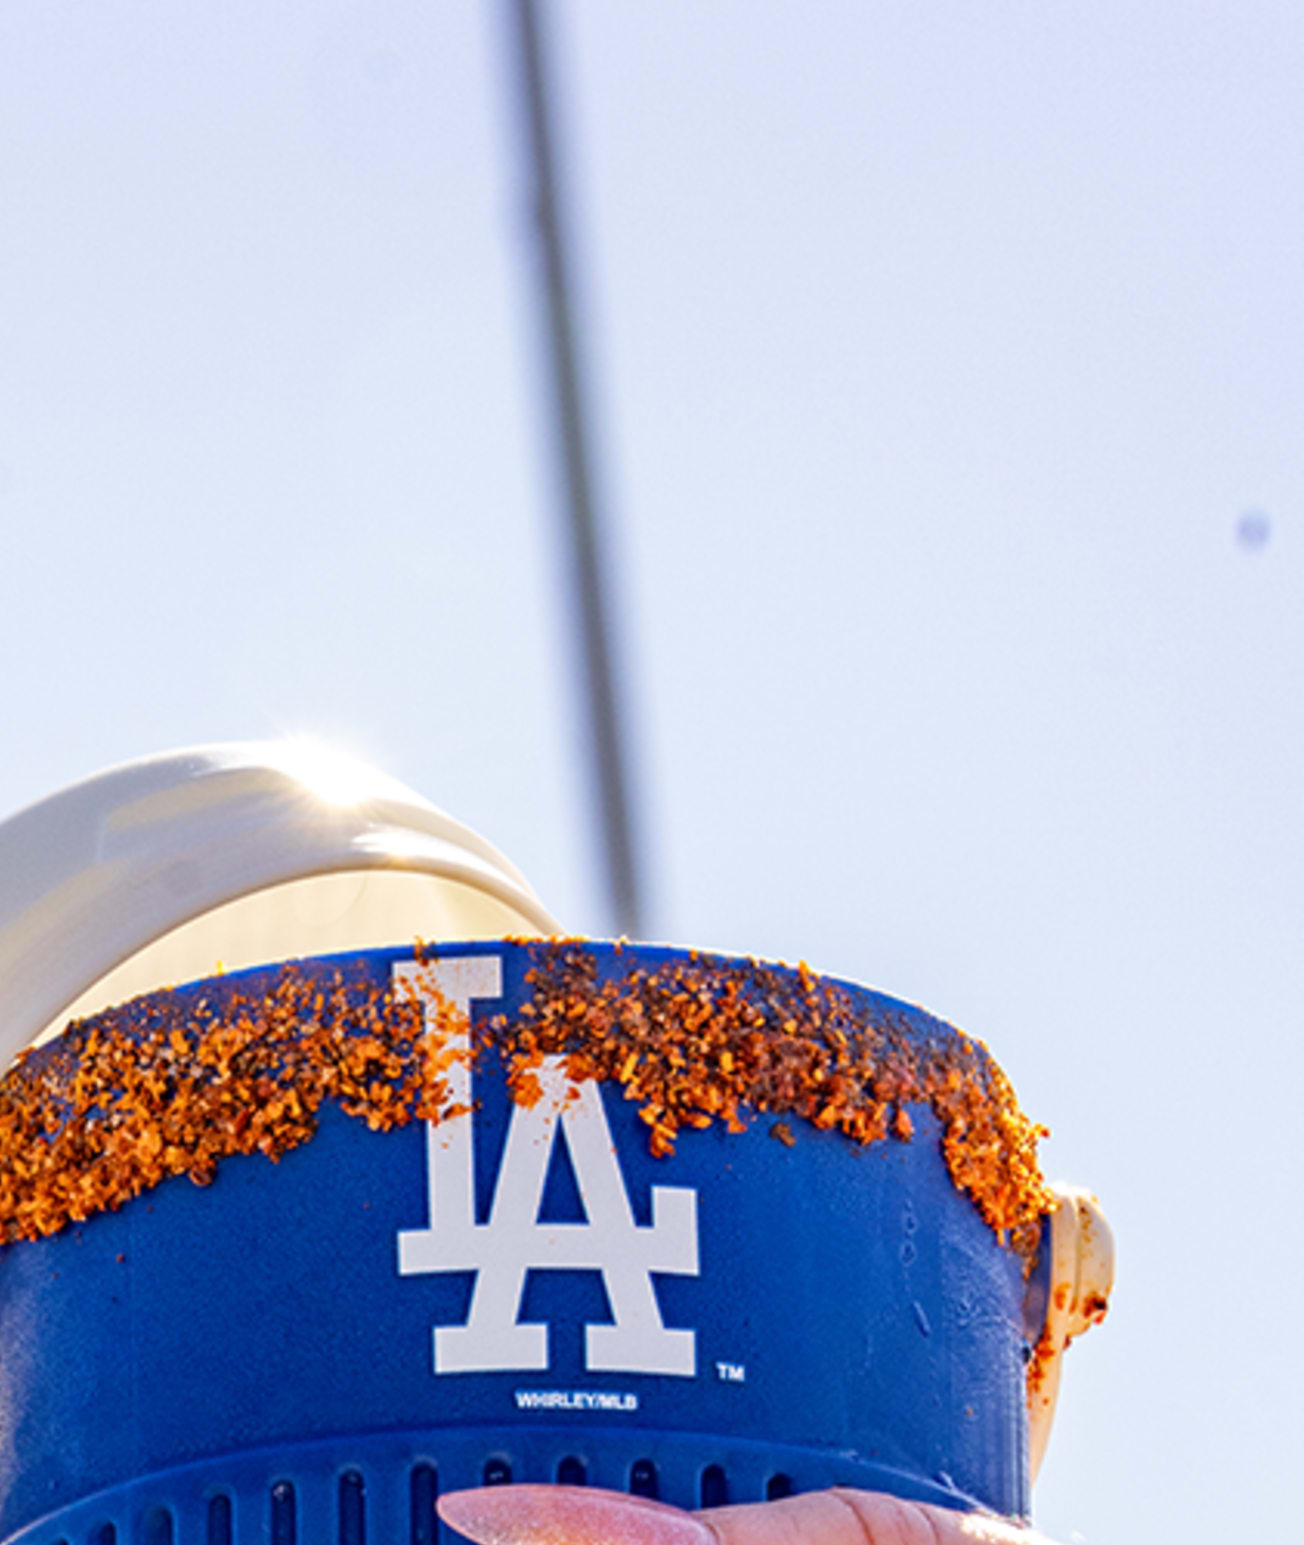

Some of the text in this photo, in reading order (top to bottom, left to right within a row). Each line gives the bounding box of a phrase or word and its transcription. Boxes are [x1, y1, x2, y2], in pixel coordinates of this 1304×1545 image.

[392, 956, 699, 1376] LA
[716, 1361, 745, 1382] TM
[514, 1391, 638, 1411] WHIRLEY/MLB
